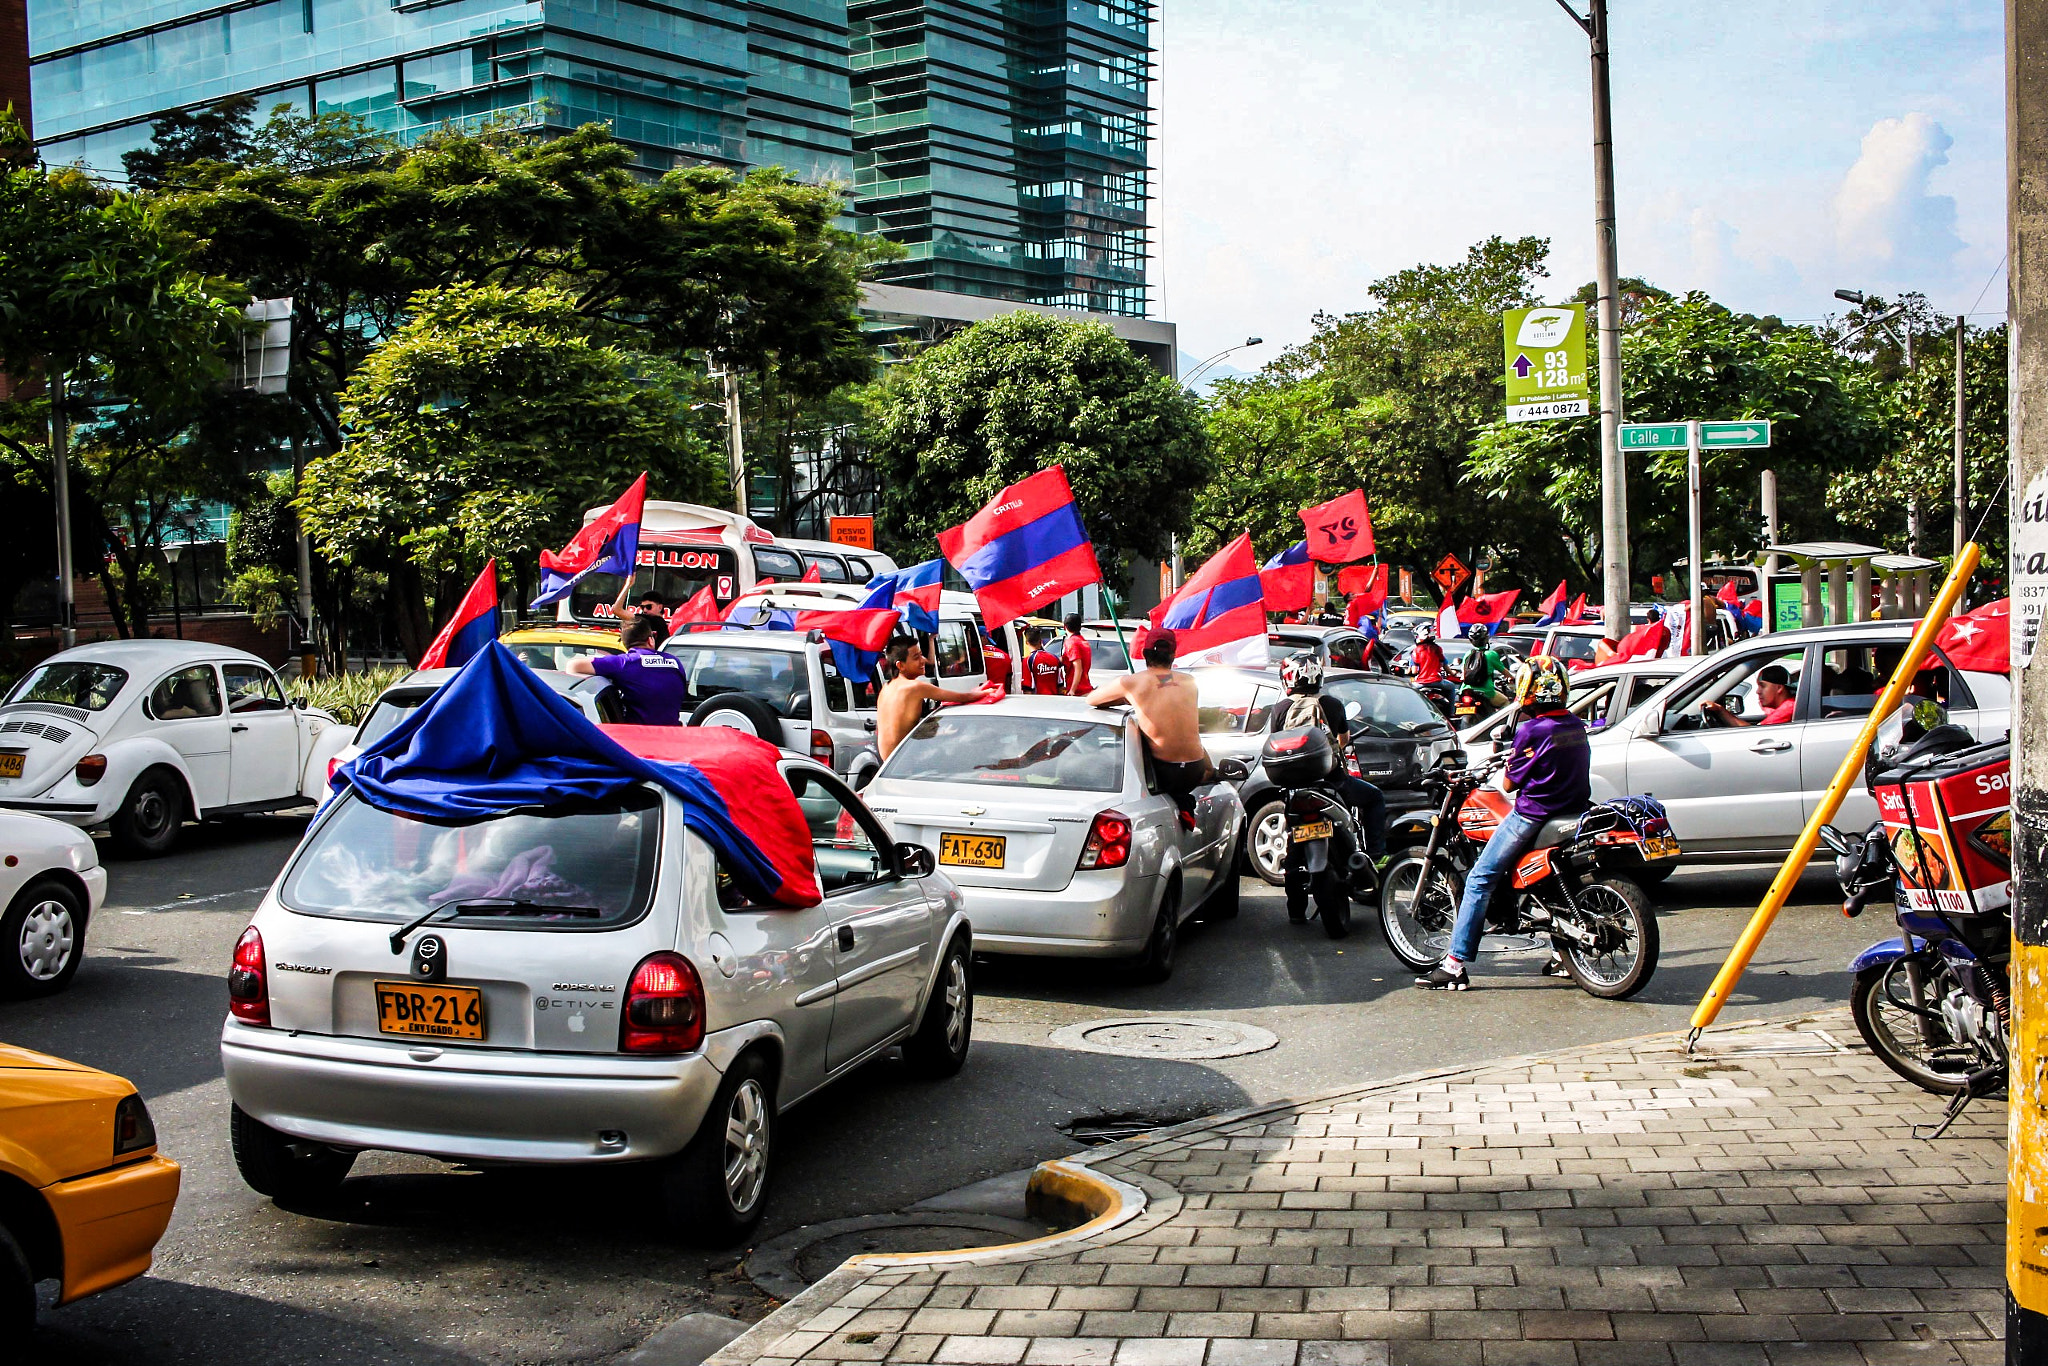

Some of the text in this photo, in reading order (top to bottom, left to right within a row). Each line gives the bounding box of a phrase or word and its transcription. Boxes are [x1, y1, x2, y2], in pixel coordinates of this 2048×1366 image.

[1544, 350, 1568, 369] 93
[1534, 369, 1568, 388] 128
[1528, 403, 1580, 416] 444 0872
[1630, 429, 1677, 444] Calle 7
[1558, 822, 1578, 834] 150
[1939, 893, 1965, 910] 1100
[275, 962, 332, 975] CHEVROLET
[552, 982, 598, 992] CORSA
[409, 1023, 453, 1035] ENVIGADO
